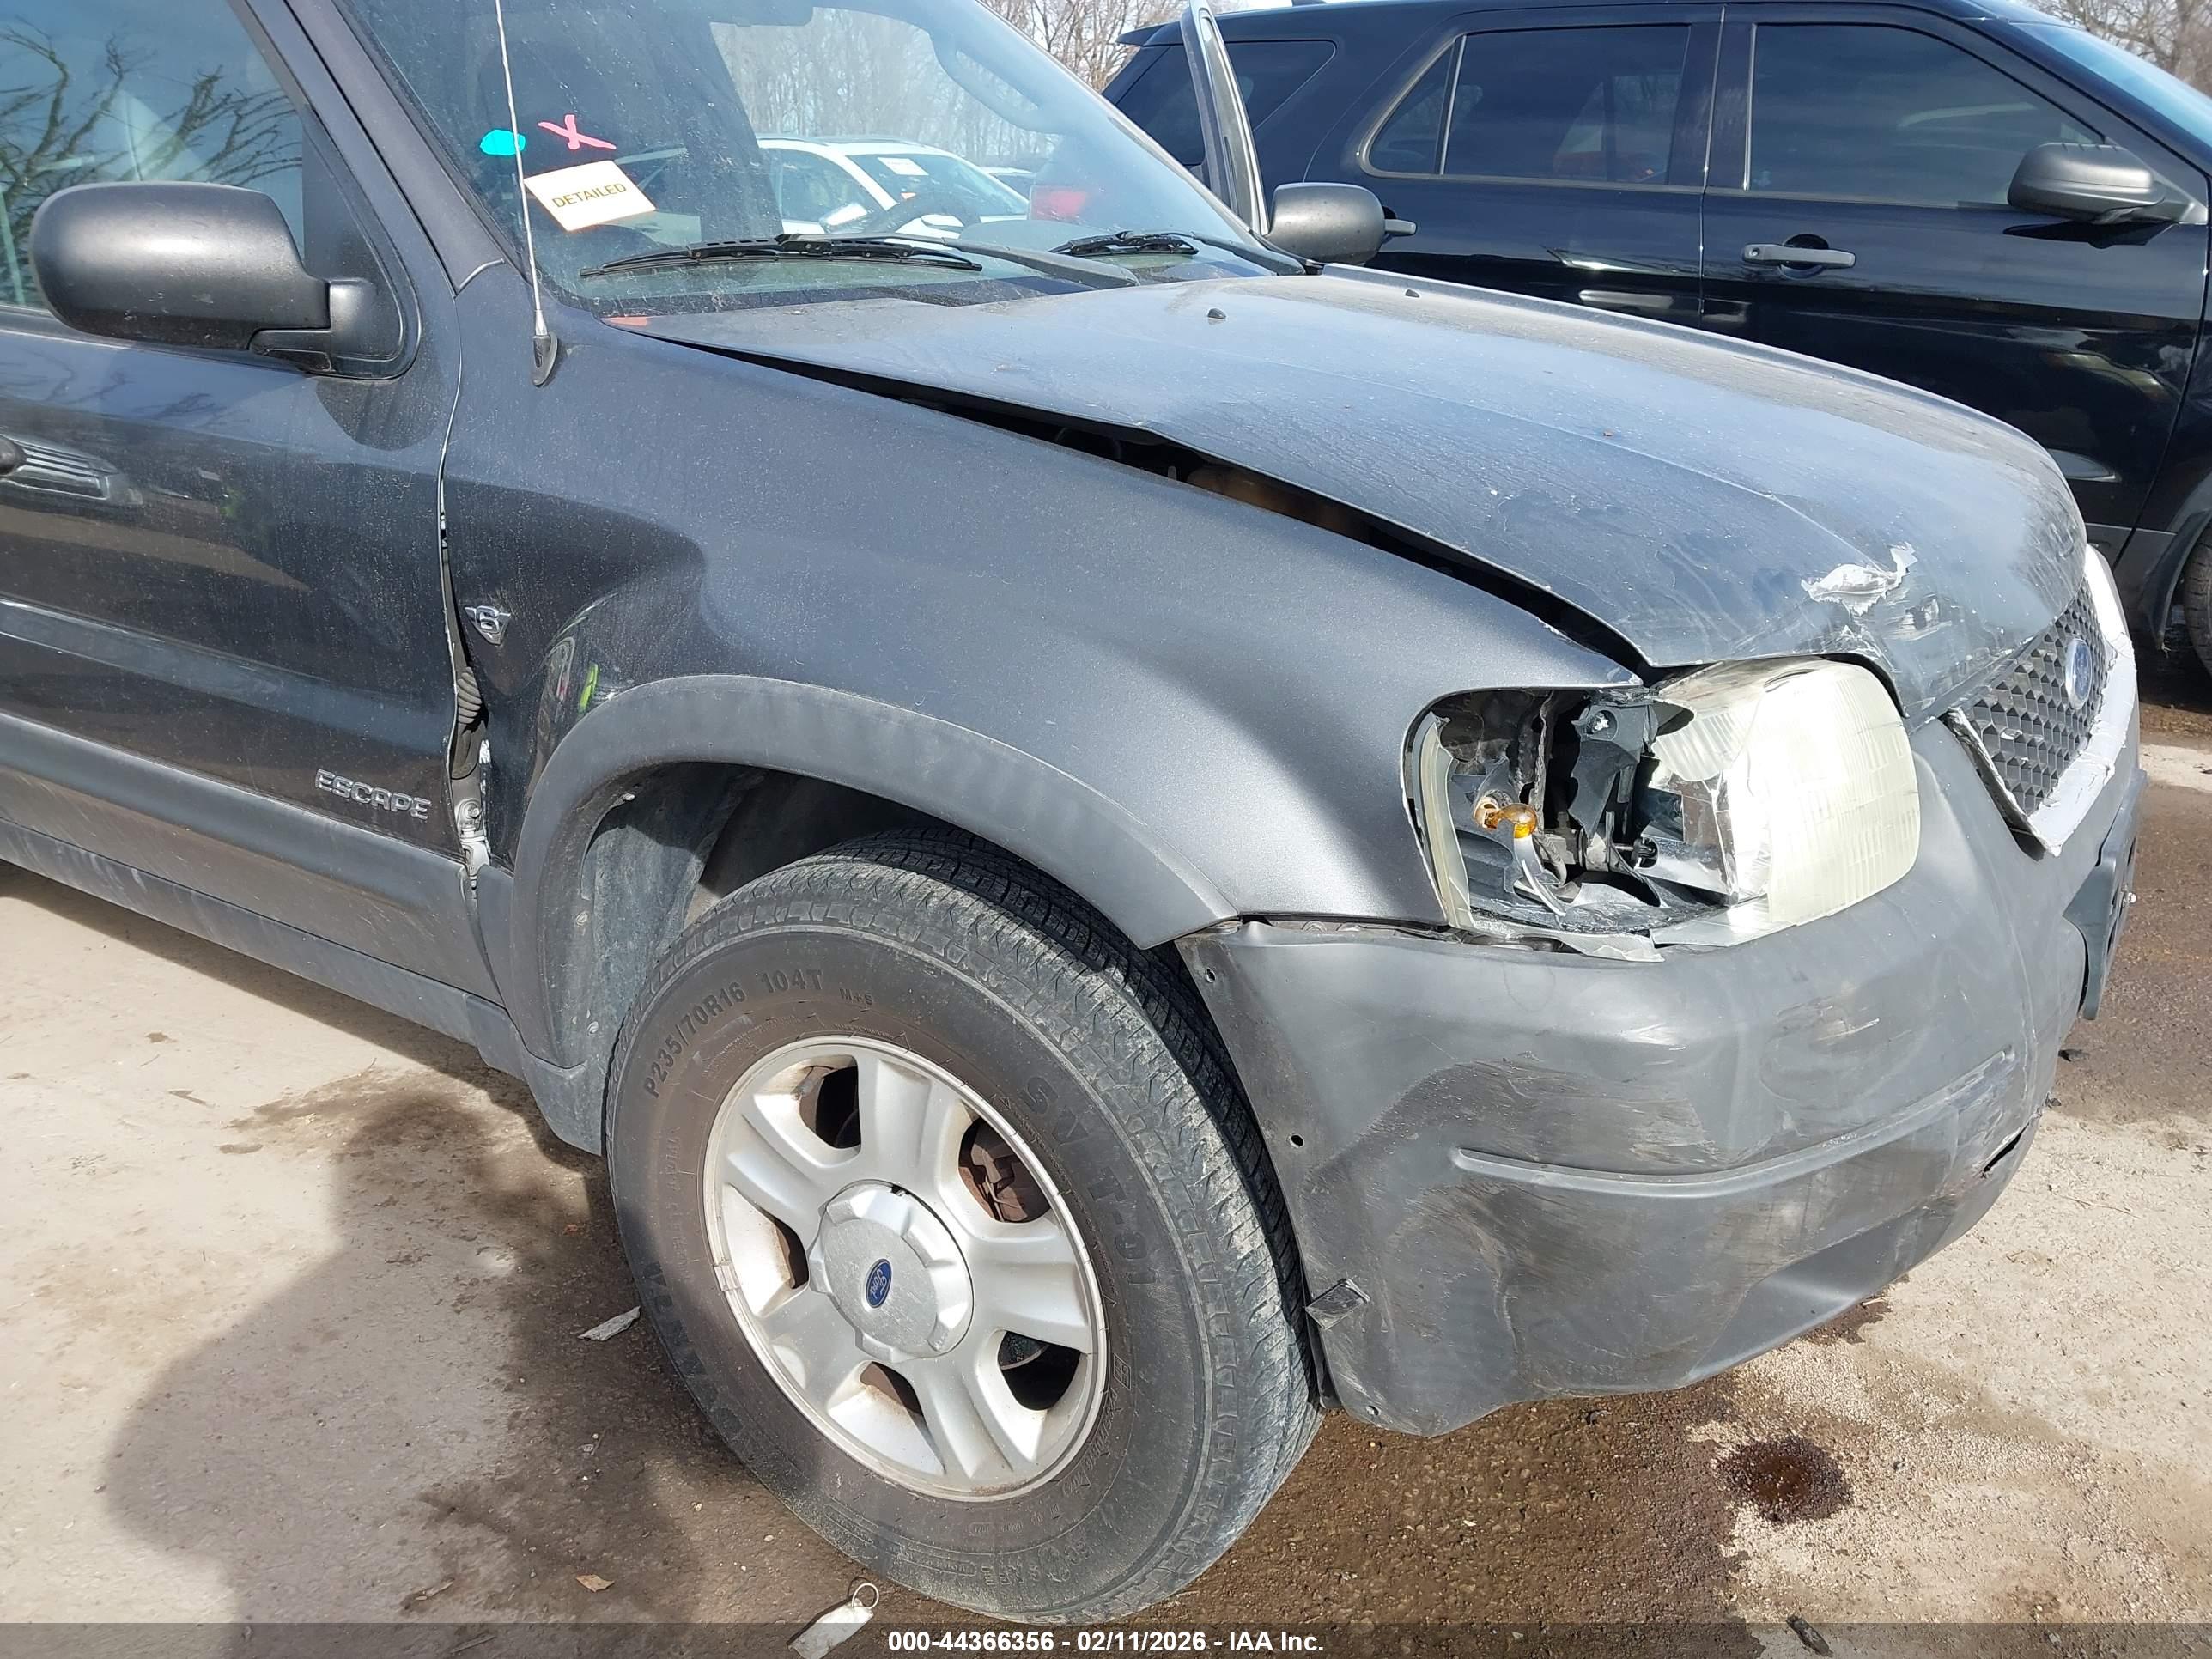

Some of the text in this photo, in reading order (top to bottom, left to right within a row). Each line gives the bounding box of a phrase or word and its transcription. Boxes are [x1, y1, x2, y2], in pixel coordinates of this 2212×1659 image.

[552, 184, 627, 207] DETAILED
[315, 769, 431, 820] ESCAPE
[838, 988, 874, 1006] M+S
[645, 981, 746, 1099] P235/70R16
[760, 969, 823, 992] 104T
[868, 1266, 888, 1300] Ford
